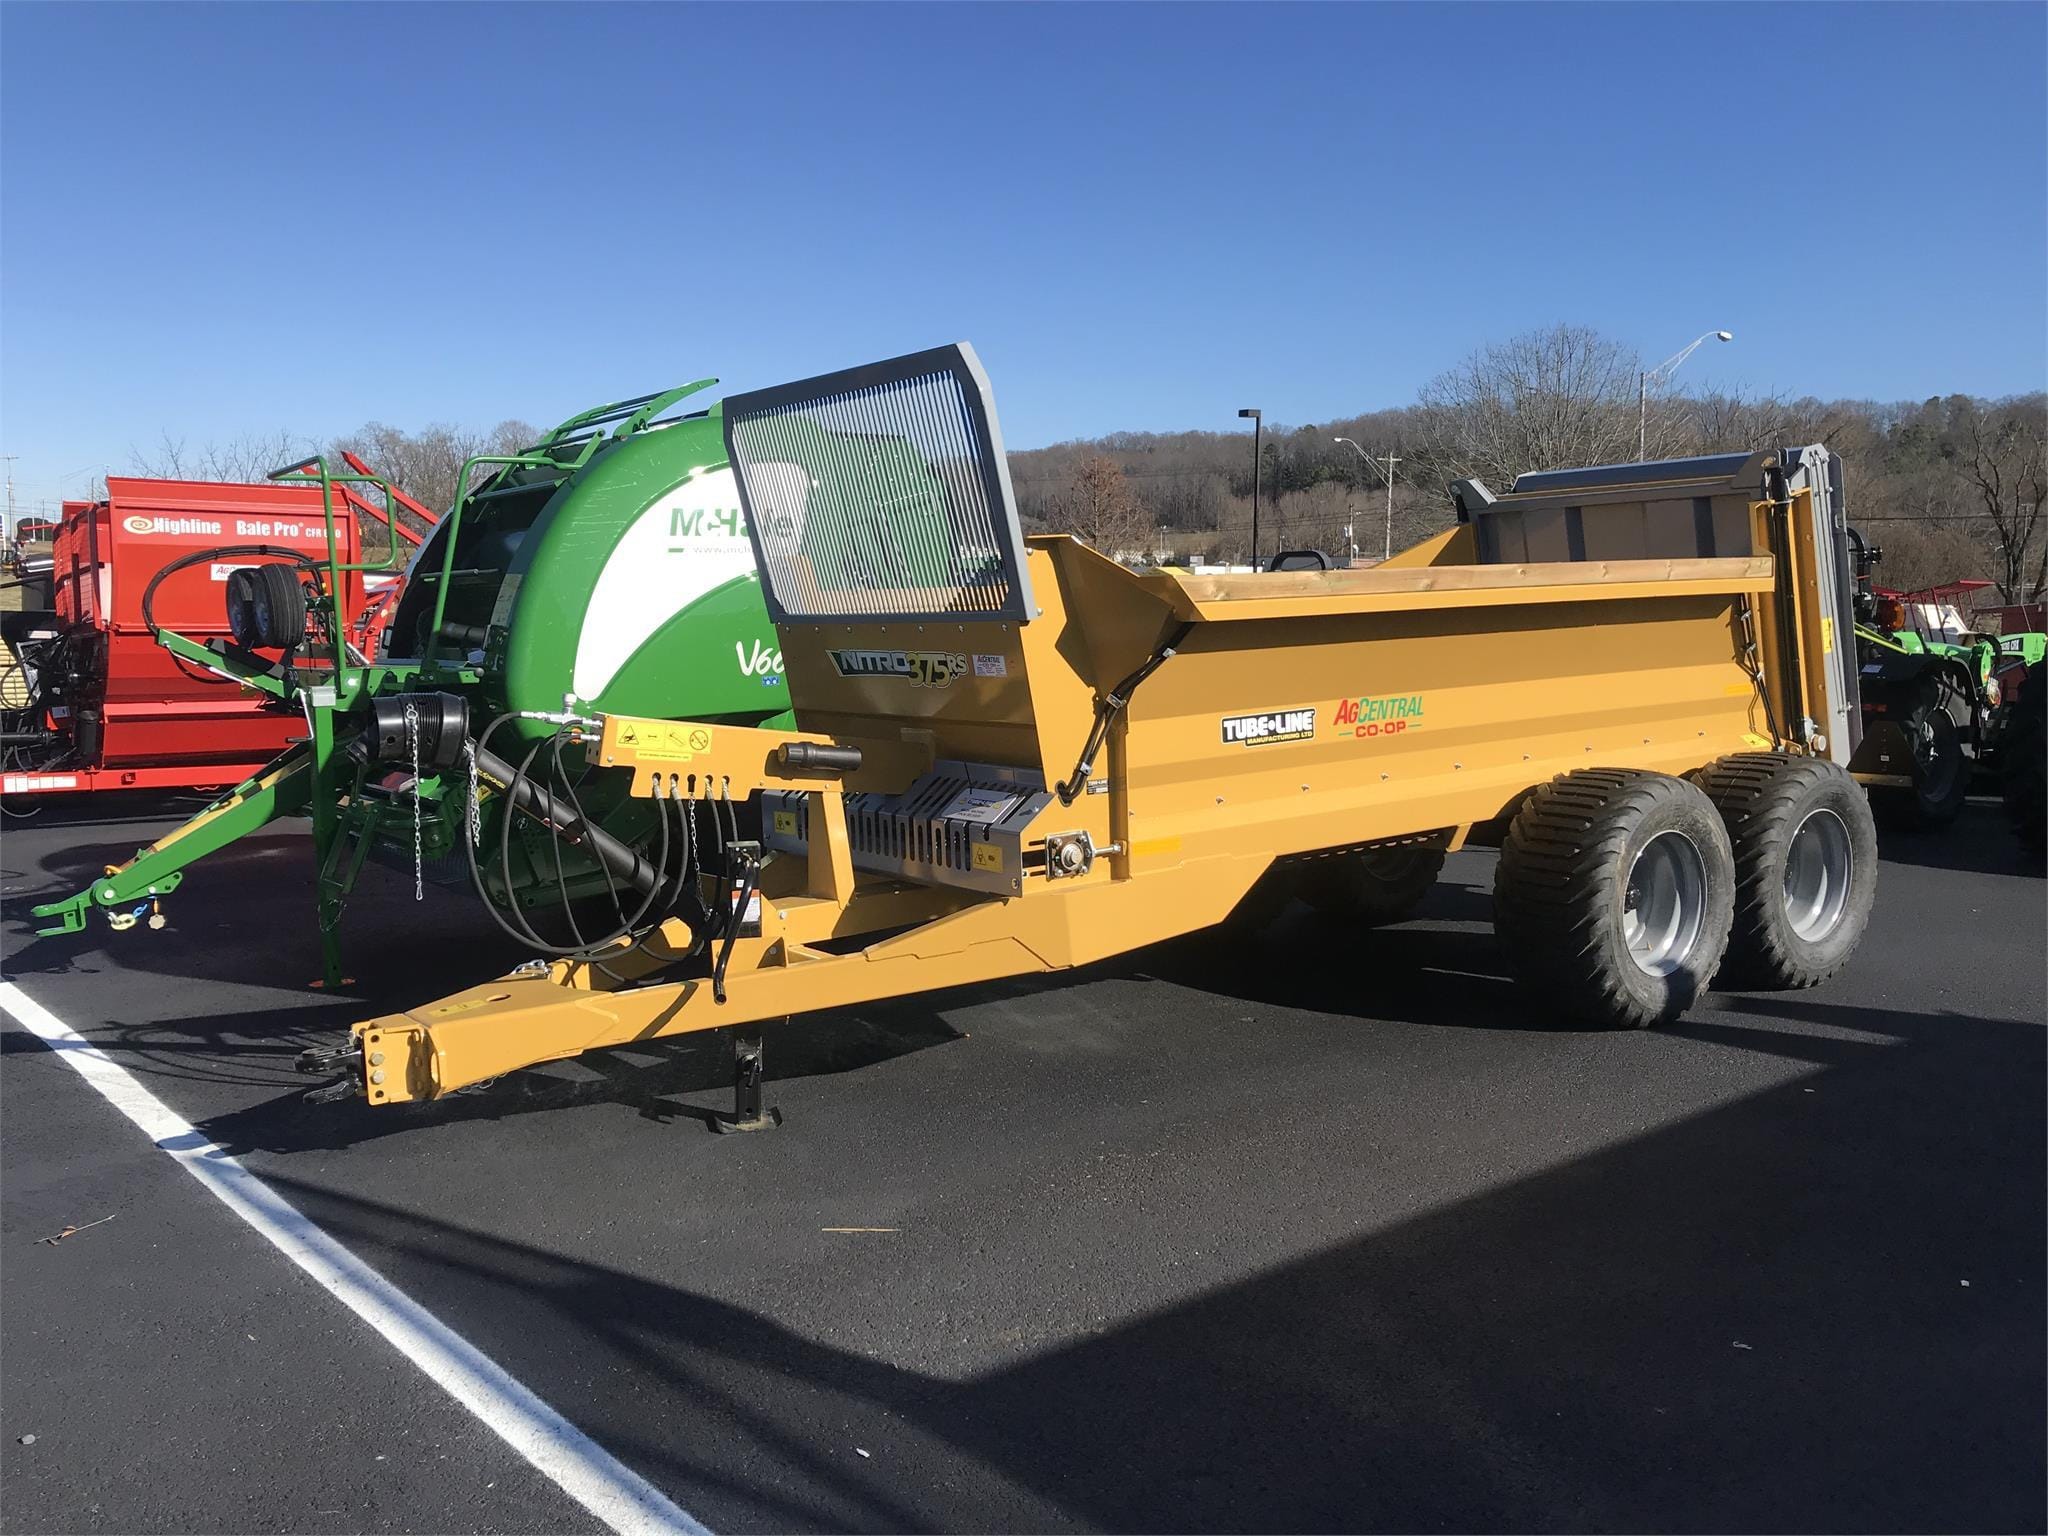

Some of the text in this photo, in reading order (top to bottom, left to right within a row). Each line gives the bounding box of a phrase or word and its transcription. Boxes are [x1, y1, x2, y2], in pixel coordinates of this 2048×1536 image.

[153, 516, 222, 535] Highline
[236, 519, 271, 536] Bale
[273, 521, 299, 537] Pro
[305, 527, 322, 538] CFR
[840, 651, 911, 673] NITRO
[1246, 730, 1313, 745] MANUFACTURING LTD
[1355, 720, 1407, 738] CO-OP
